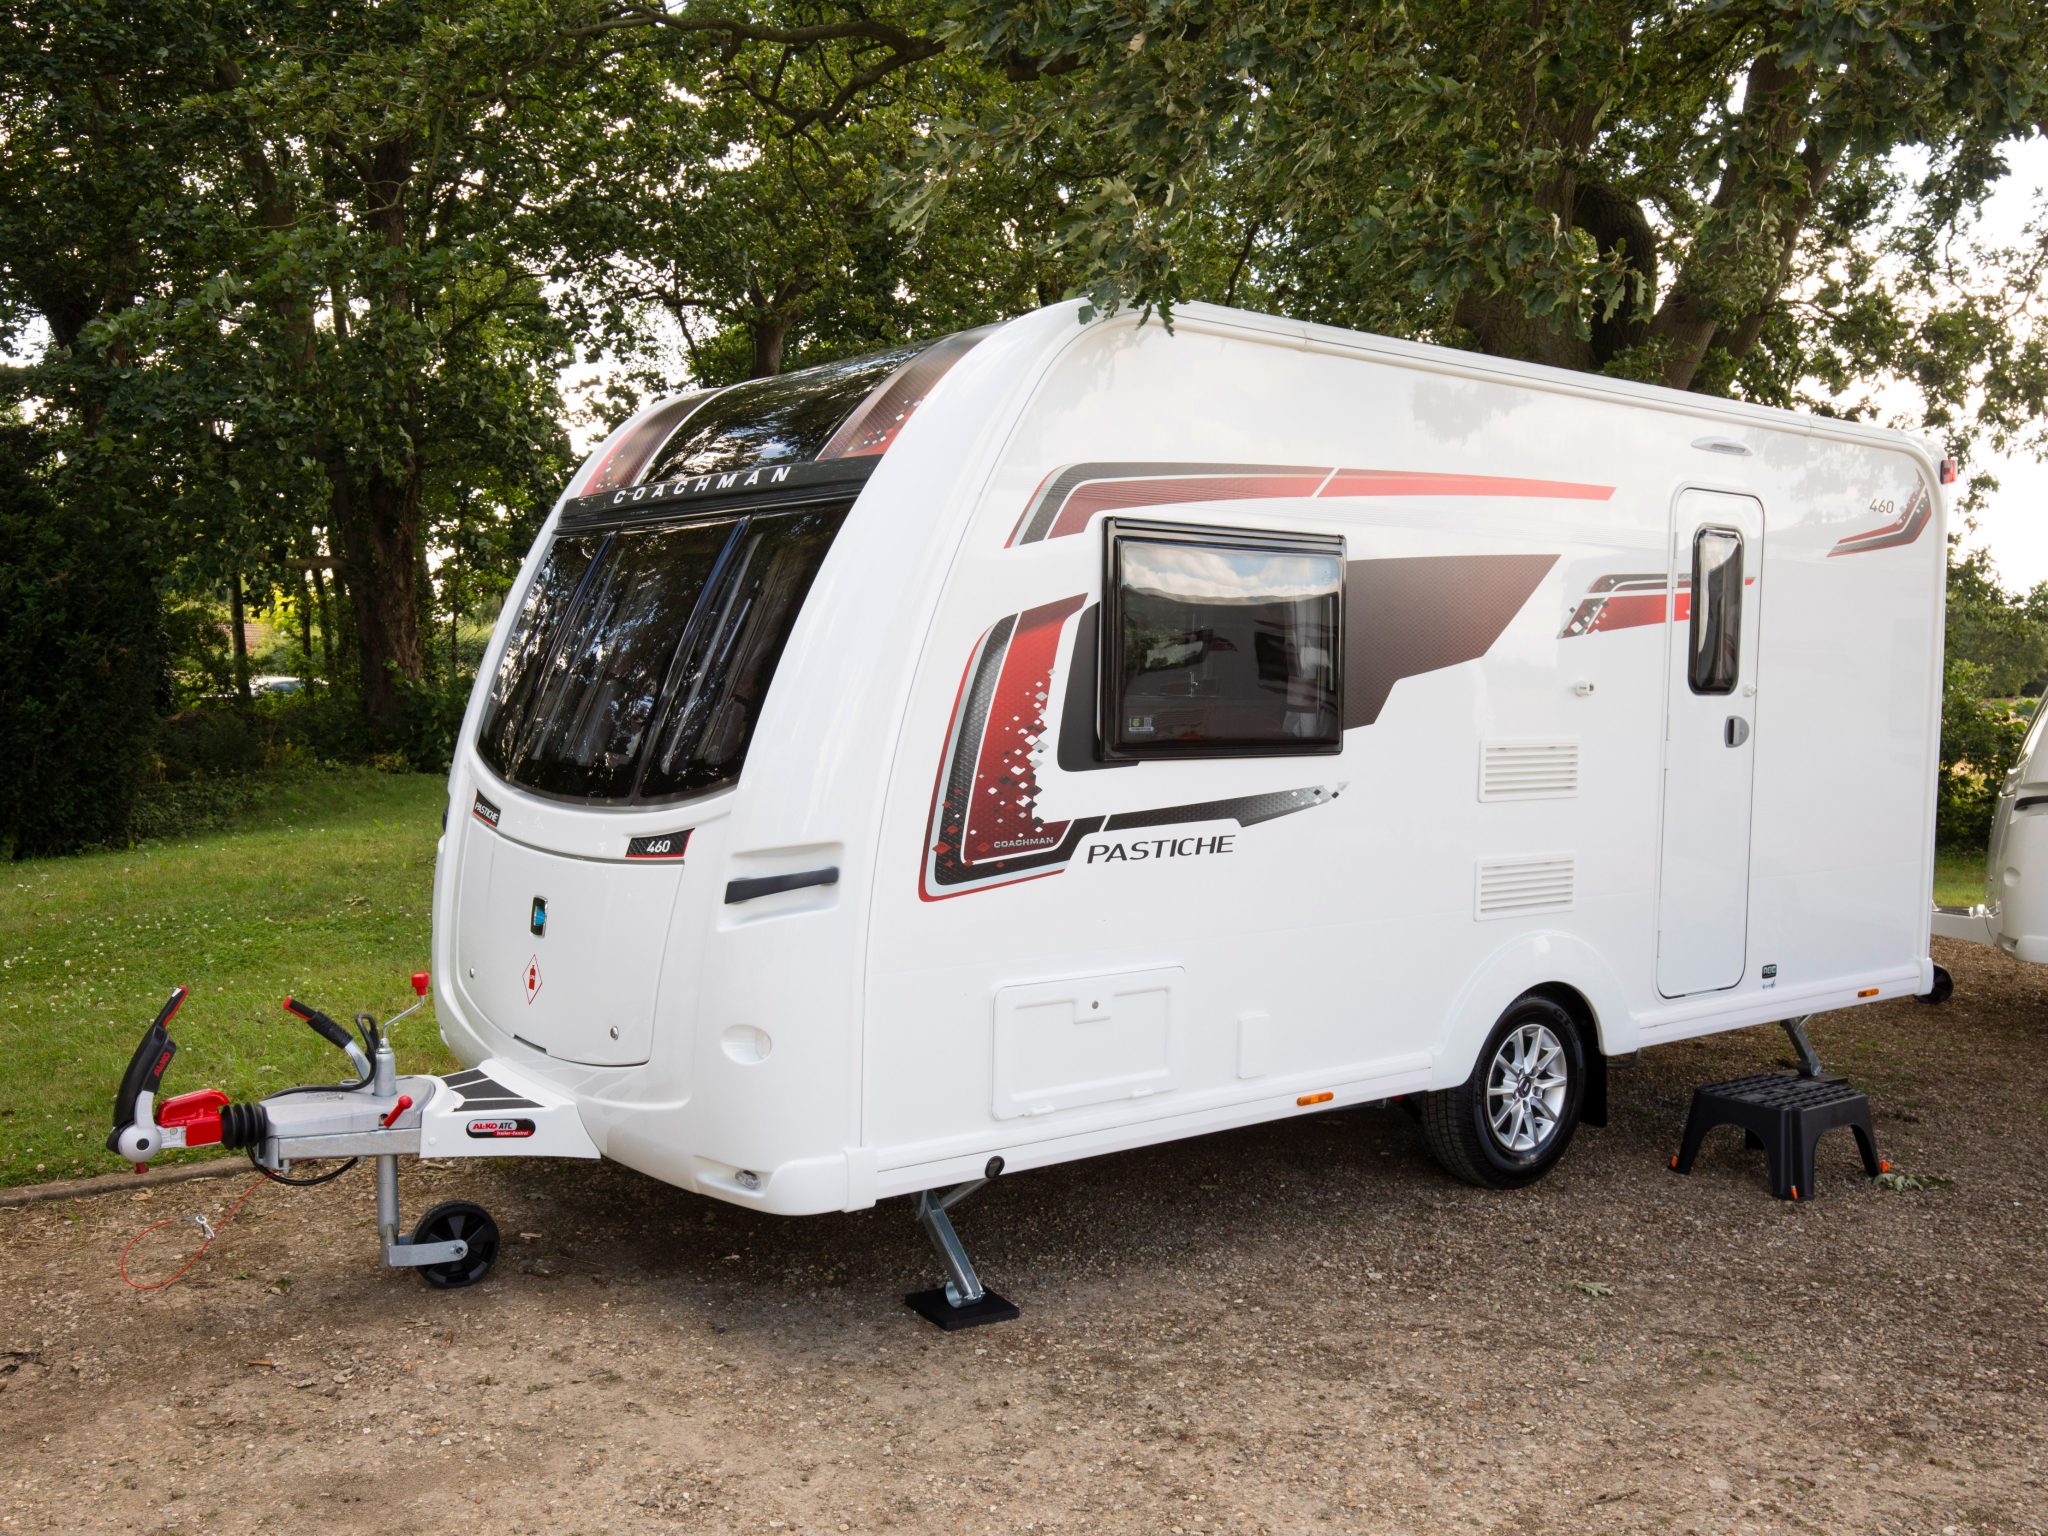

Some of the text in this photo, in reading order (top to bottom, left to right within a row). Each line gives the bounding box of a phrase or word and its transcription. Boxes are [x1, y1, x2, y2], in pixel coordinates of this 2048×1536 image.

[613, 466, 792, 504] COACHMAN
[1869, 498, 1894, 514] 460
[474, 801, 499, 823] PASTICHE
[646, 840, 671, 853] 460
[993, 836, 1055, 849] COACHMAN
[1086, 834, 1237, 865] PASTICHE
[498, 1122, 513, 1130] ATC
